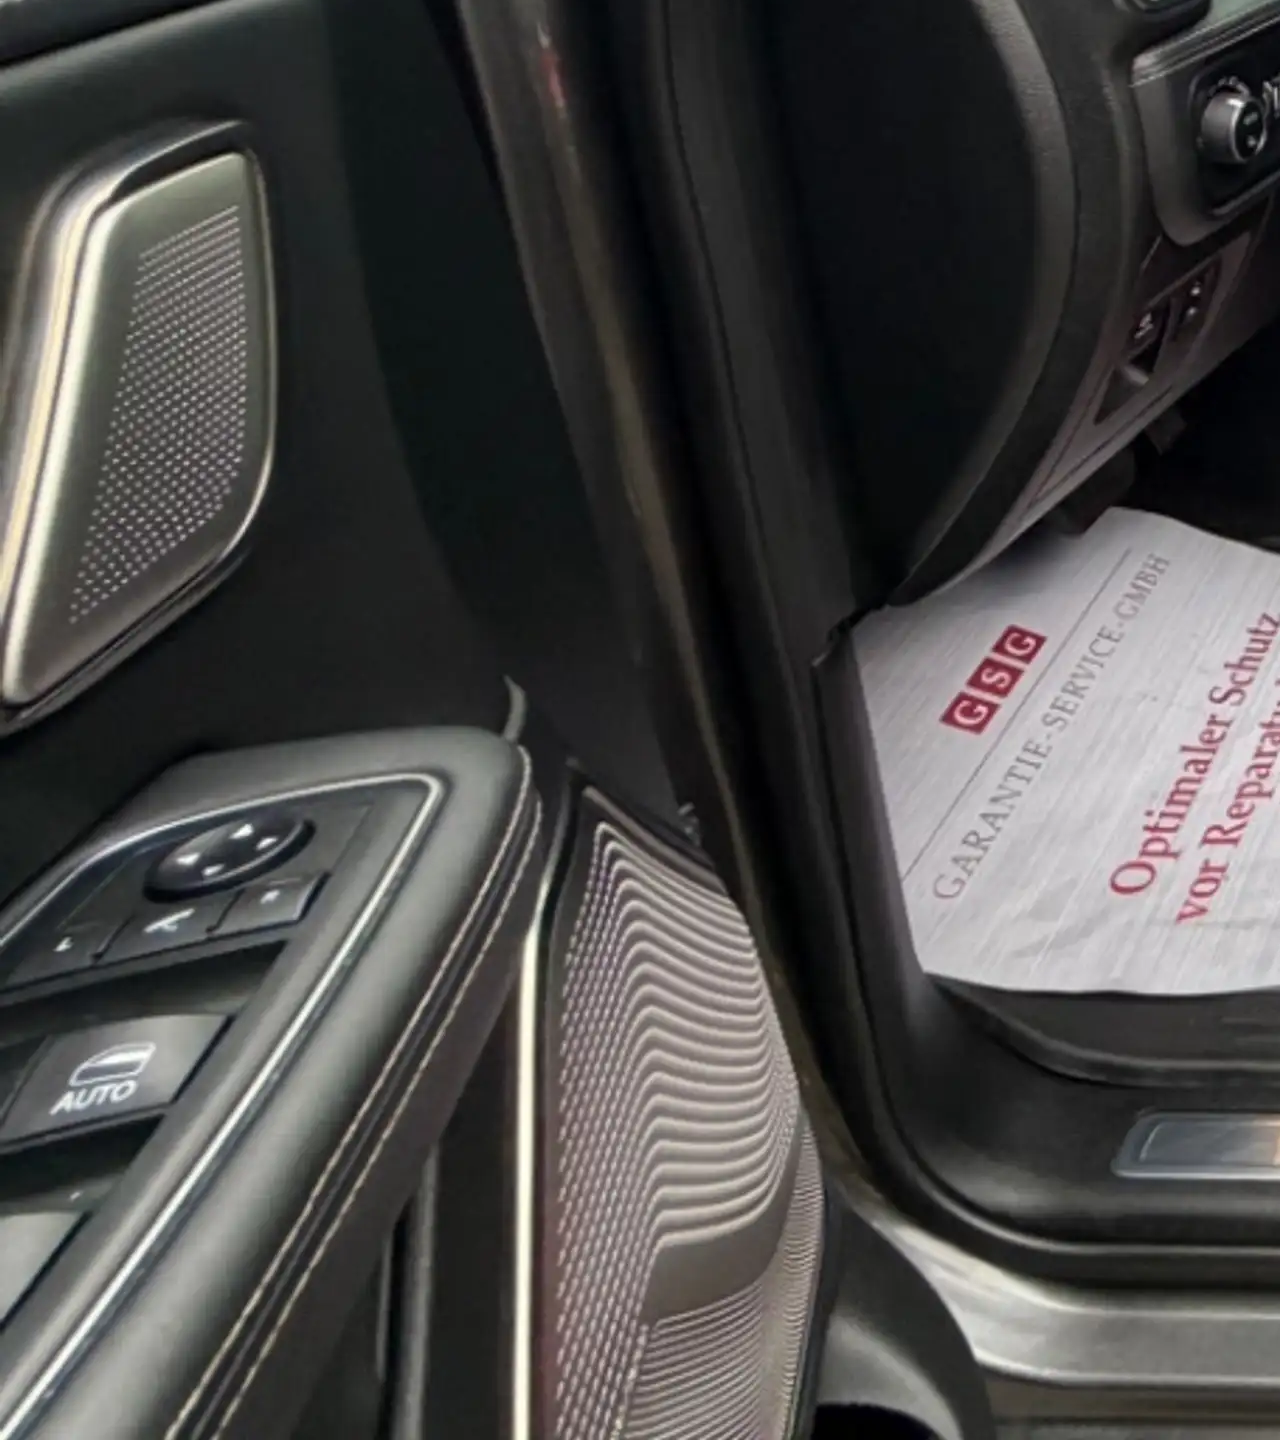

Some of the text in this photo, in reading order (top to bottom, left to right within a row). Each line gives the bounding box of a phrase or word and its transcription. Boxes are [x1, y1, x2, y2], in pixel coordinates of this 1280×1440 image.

[950, 629, 1040, 729] GSG
[1109, 713, 1234, 895] Optimaler
[1174, 859, 1230, 925] vor
[48, 1079, 137, 1116] AUTO
